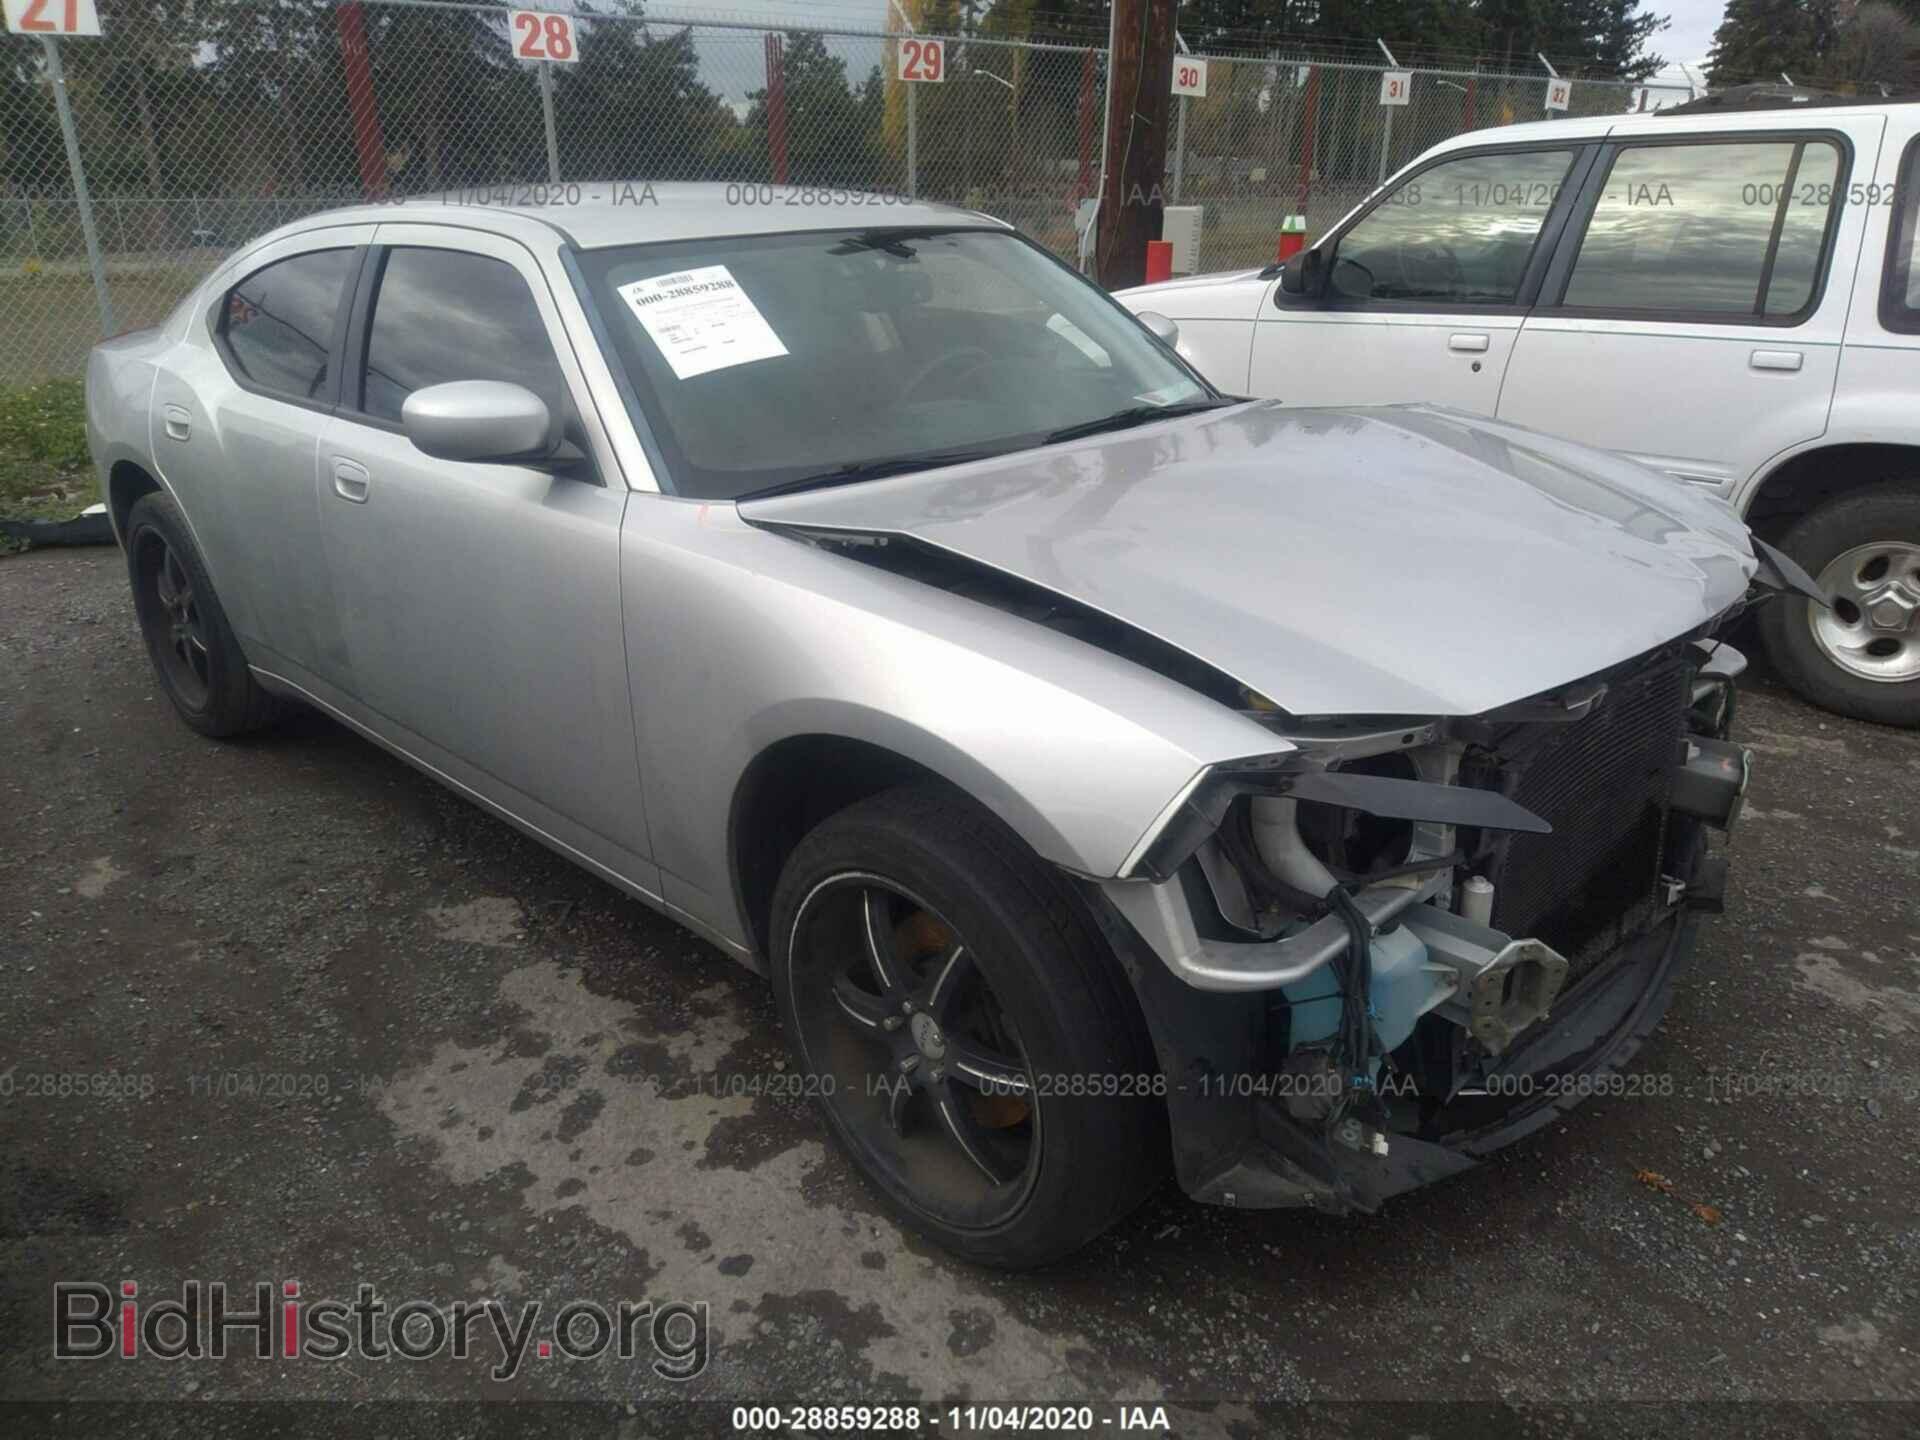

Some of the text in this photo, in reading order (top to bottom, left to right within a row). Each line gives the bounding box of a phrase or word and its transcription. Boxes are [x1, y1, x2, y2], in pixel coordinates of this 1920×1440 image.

[515, 13, 572, 60] 28
[903, 40, 942, 80] 29
[1179, 67, 1198, 88] 30
[1390, 80, 1404, 98] 31
[635, 279, 735, 307] 000-28859288
